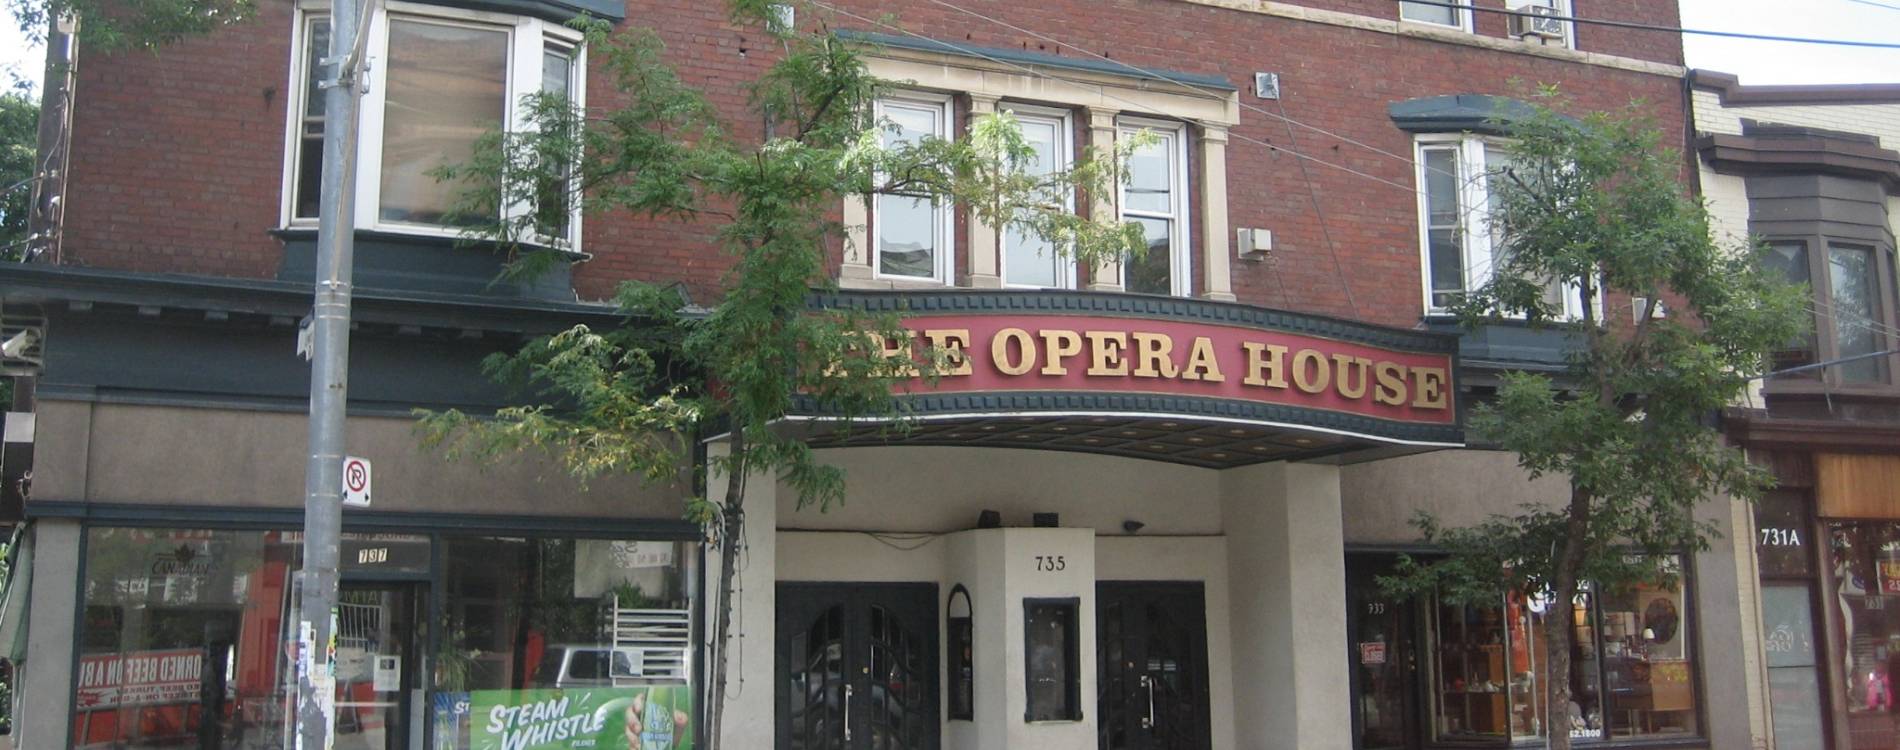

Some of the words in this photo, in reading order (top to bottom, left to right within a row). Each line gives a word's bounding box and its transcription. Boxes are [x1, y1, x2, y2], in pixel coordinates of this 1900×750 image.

[991, 327, 1226, 382] OPERA
[1242, 341, 1448, 409] HOUSE
[1761, 528, 1800, 546] 731A
[358, 548, 388, 564] 737
[1035, 556, 1066, 572] 735
[485, 696, 570, 734] STEAM
[502, 708, 608, 750] WHISTLE
